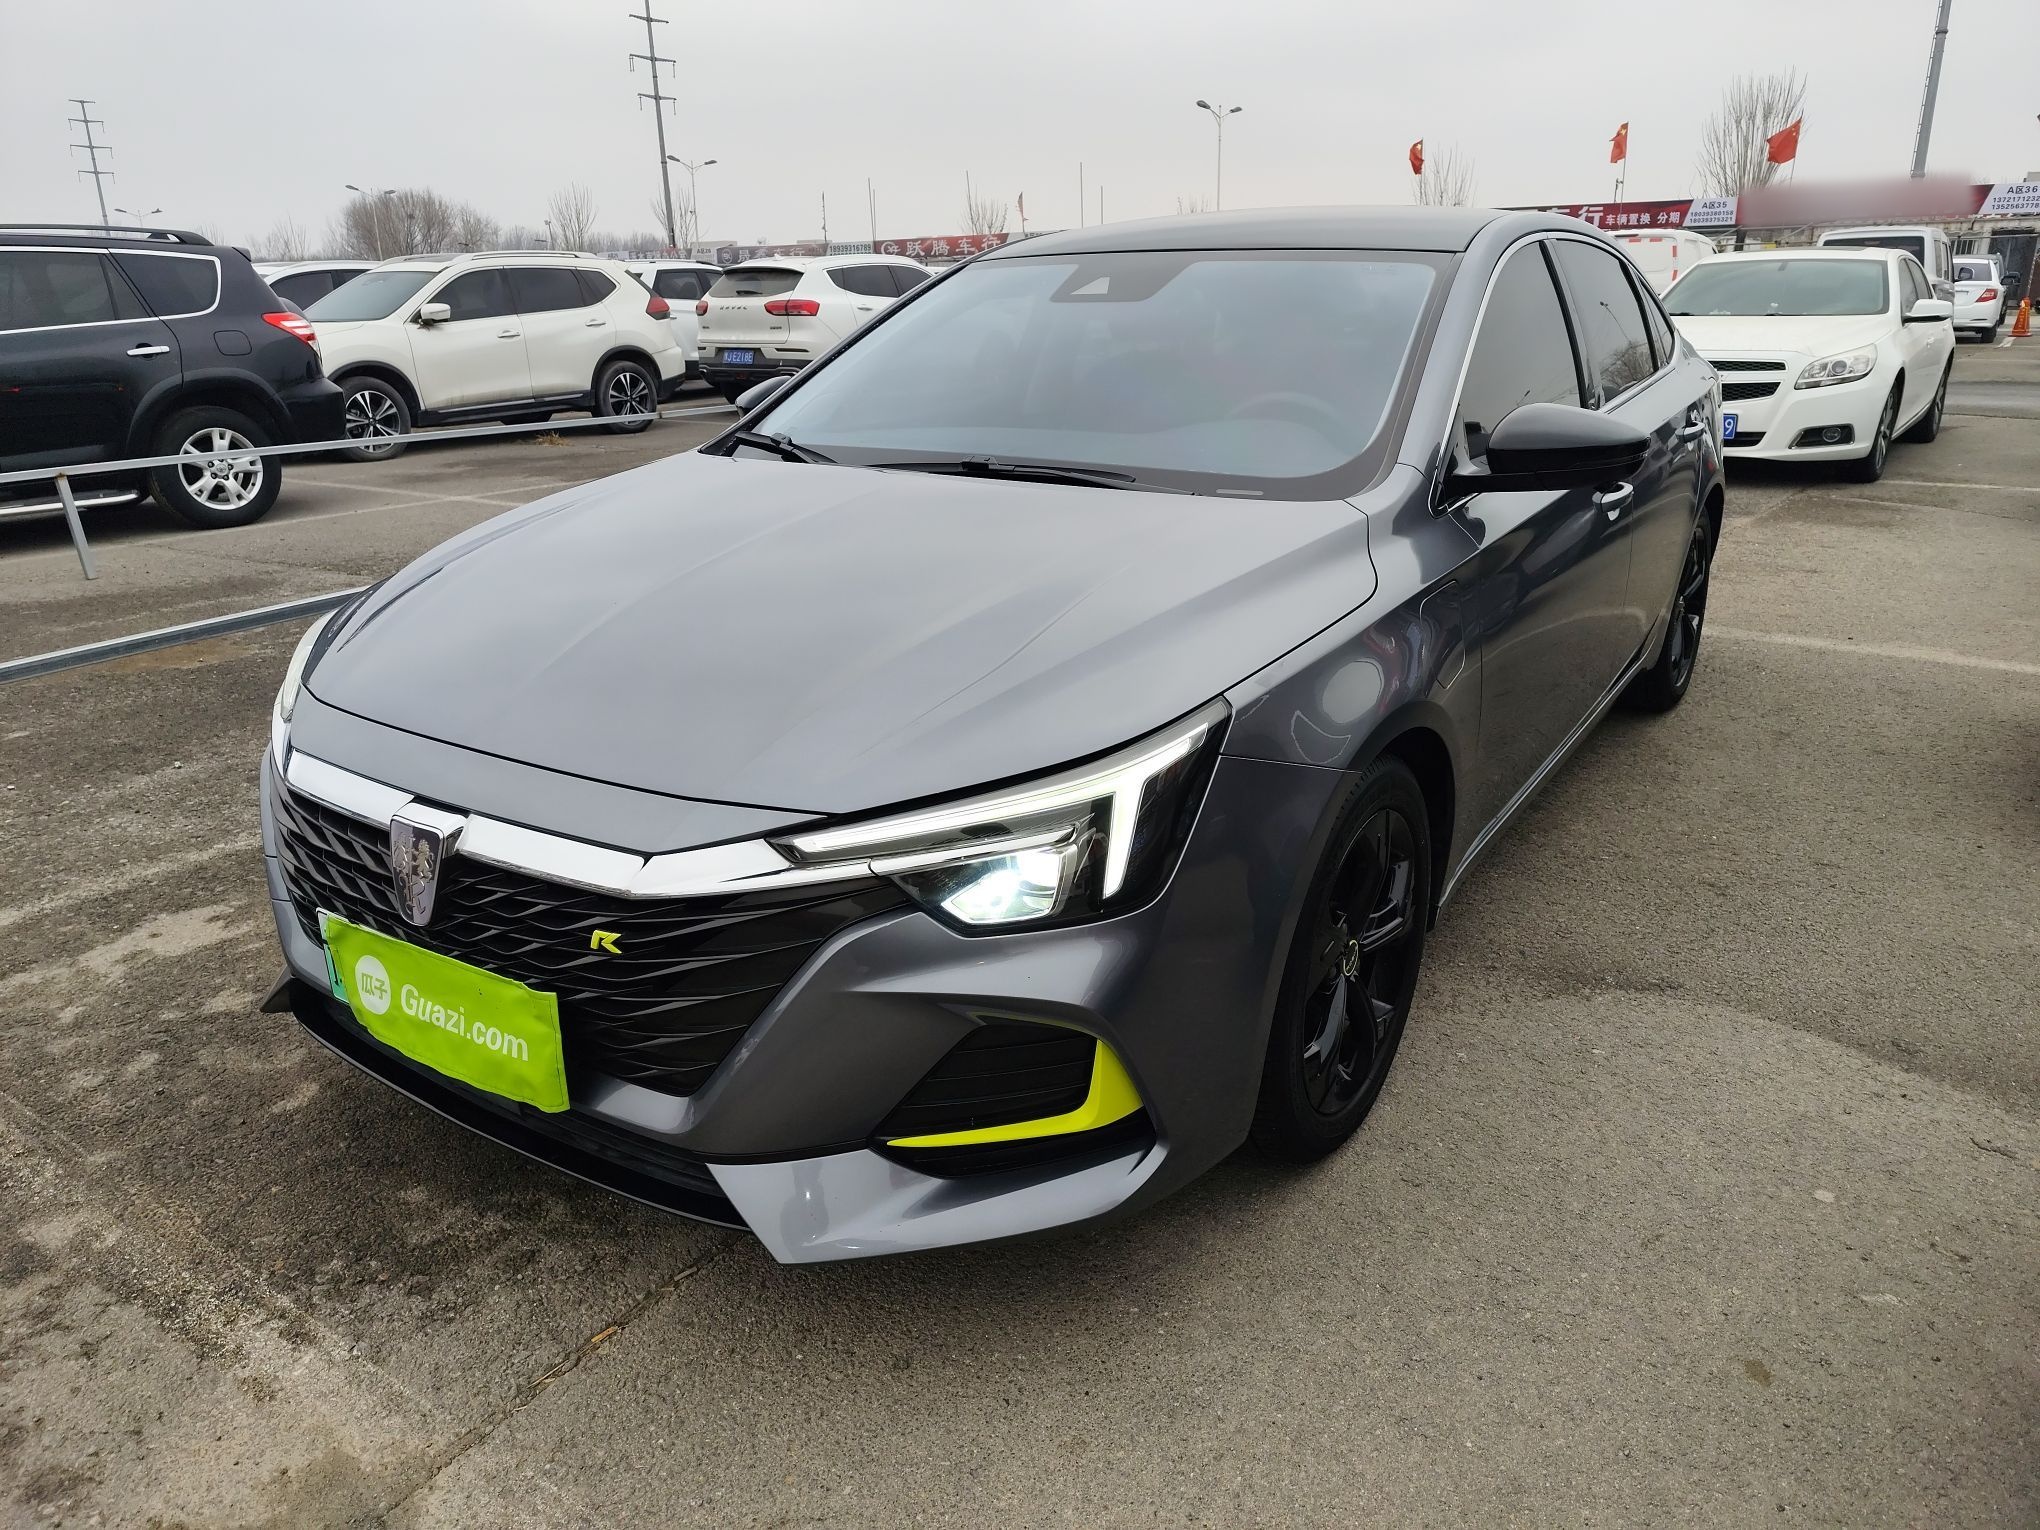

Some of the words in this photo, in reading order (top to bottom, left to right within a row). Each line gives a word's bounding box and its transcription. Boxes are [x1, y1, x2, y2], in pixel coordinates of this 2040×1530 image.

[2007, 185, 2038, 194] A区36
[1702, 201, 1728, 210] A区35
[1605, 213, 1651, 226] 车辆置换
[1657, 211, 1681, 224] 分期
[906, 234, 1001, 257] 跃腾车行
[361, 972, 388, 1001] 瓜子
[400, 983, 529, 1062] Guazi.com
